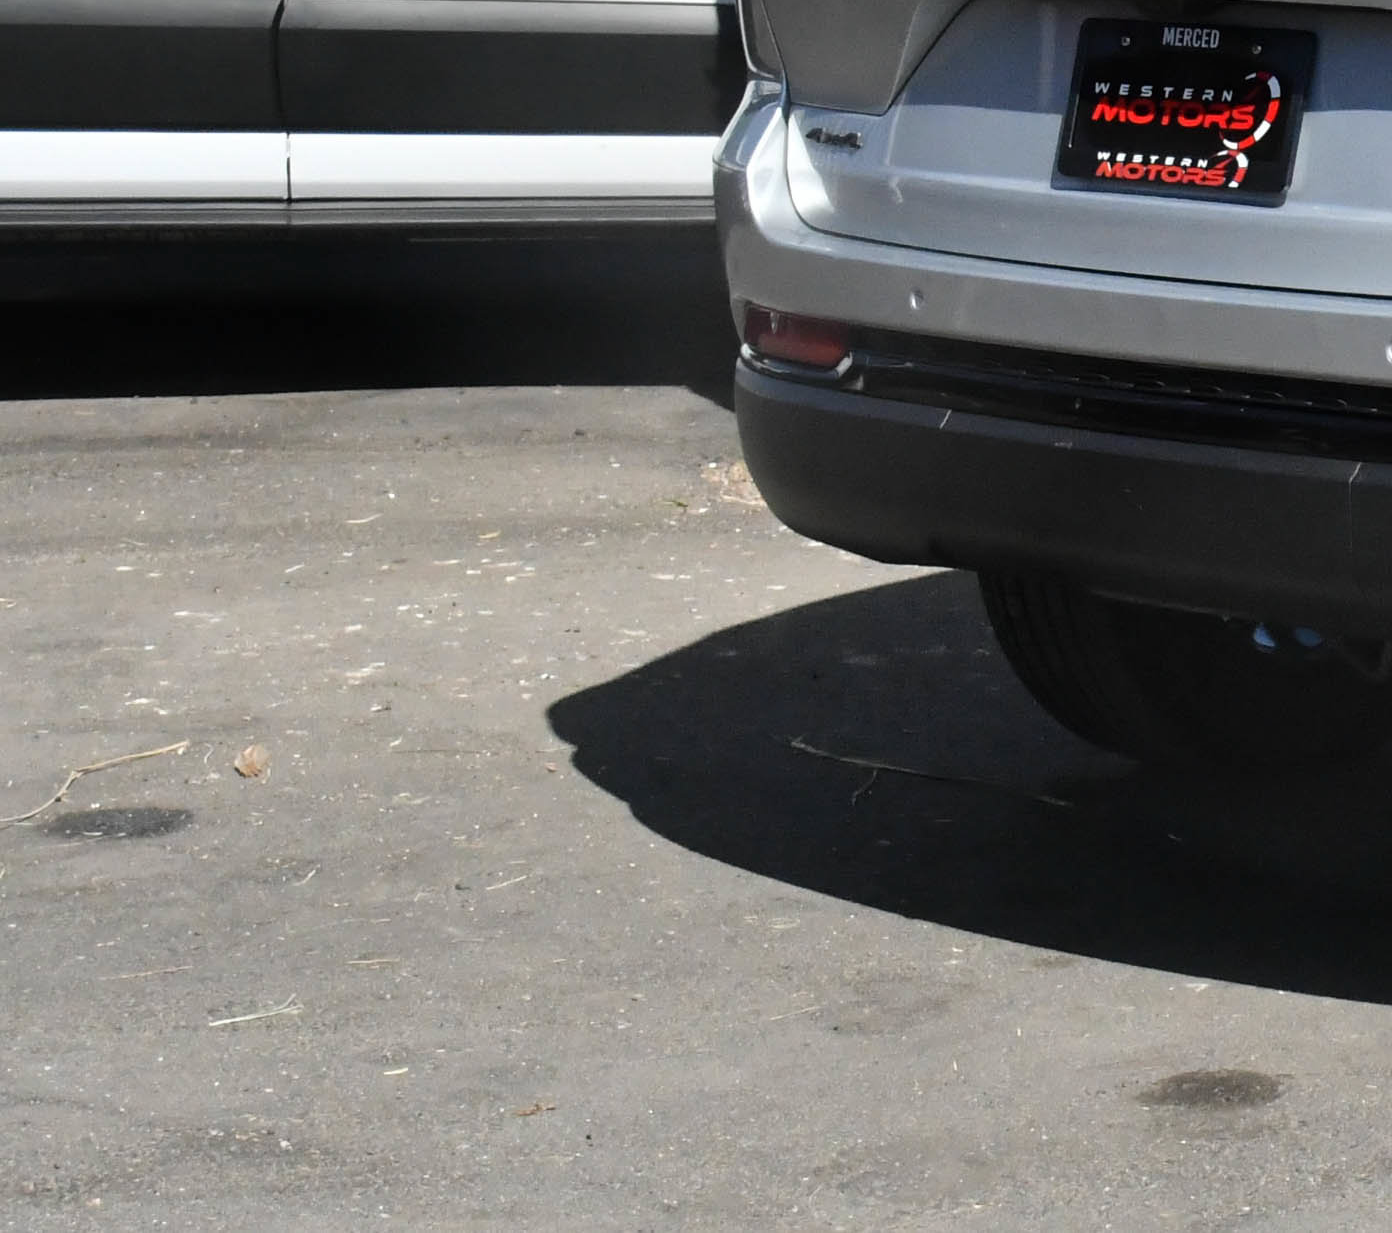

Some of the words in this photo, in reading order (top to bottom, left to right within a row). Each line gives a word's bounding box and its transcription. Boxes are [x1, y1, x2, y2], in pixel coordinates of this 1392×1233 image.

[1162, 26, 1220, 49] MERCED
[1095, 82, 1233, 102] WESTERN
[1091, 98, 1256, 130] MOTORS
[1097, 151, 1208, 168] WESTERN
[1096, 162, 1227, 186] MOTORS
